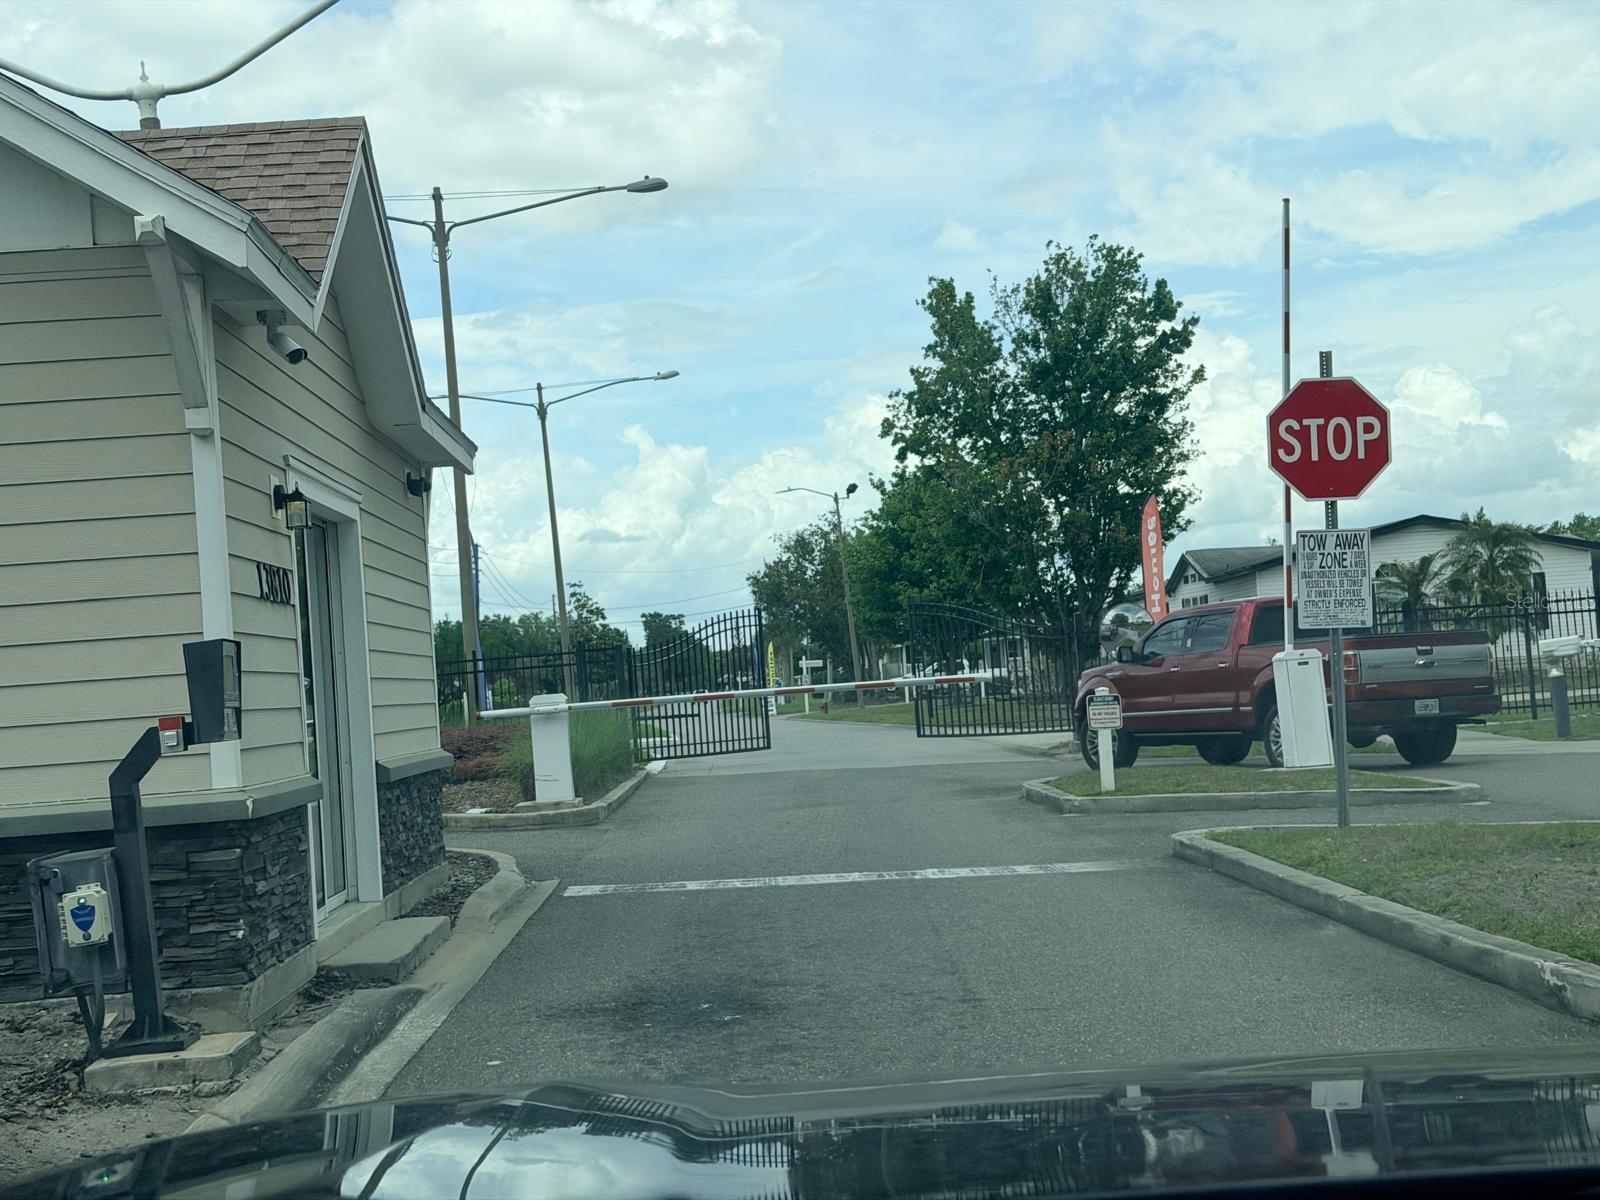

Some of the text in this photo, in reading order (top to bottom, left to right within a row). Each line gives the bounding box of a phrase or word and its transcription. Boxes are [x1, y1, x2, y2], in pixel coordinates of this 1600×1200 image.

[1277, 416, 1381, 463] STOP
[1300, 532, 1366, 551] TOW AWAY
[1319, 551, 1348, 569] ZONE
[1354, 560, 1367, 568] WEEK
[1301, 570, 1336, 579] UNAUTHORIZED
[1337, 569, 1359, 578] VEHICLES
[1305, 579, 1363, 589] VESSELS WILL BE TOWED
[1307, 590, 1313, 598] AT
[1339, 588, 1362, 597] EXPENSE
[1304, 598, 1366, 609] STRICTLY ENFORCED
